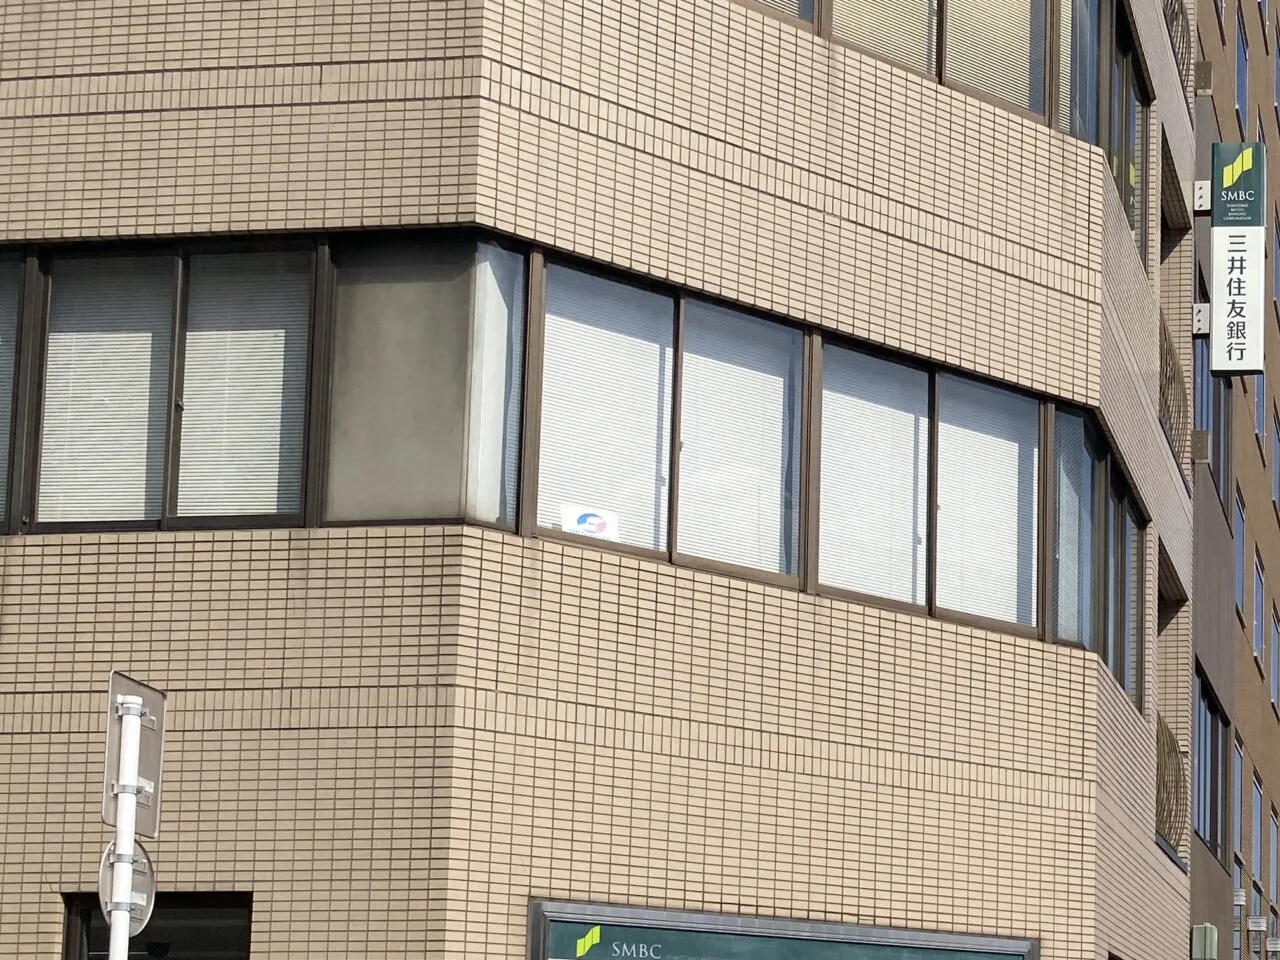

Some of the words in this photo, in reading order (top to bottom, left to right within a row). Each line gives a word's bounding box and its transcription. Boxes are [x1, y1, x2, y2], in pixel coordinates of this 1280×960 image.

[1221, 190, 1255, 201] SMBC
[1226, 234, 1247, 361] 三井住友銀行
[611, 941, 662, 960] SMBC
